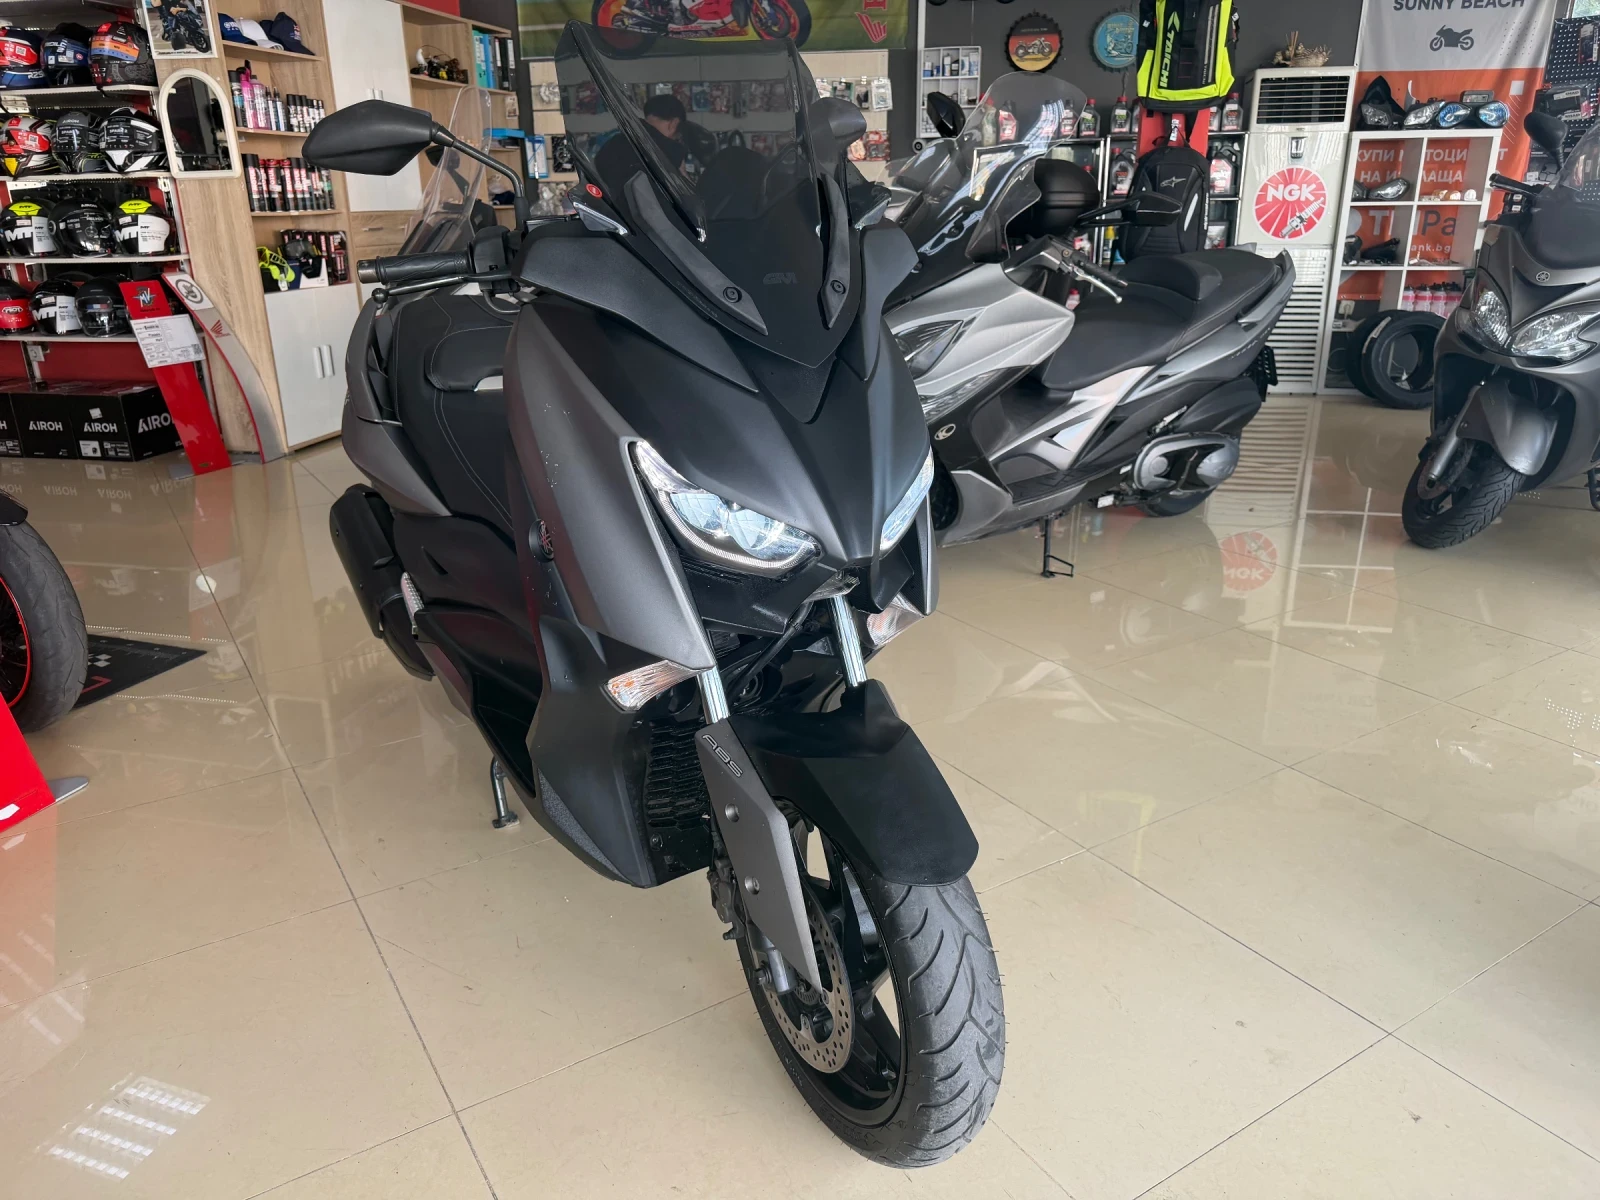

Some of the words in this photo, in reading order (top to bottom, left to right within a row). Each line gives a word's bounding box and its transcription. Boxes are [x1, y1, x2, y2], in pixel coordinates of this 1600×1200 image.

[1159, 30, 1175, 88] TAICHI
[1360, 171, 1381, 182] НА
[1266, 184, 1316, 202] NGK
[5, 227, 34, 242] MT
[114, 226, 139, 242] MT
[32, 306, 57, 320] MT
[29, 421, 63, 431] AIROH
[83, 422, 118, 433] AIROH
[137, 412, 174, 433] AIRO
[702, 734, 743, 778] ABS
